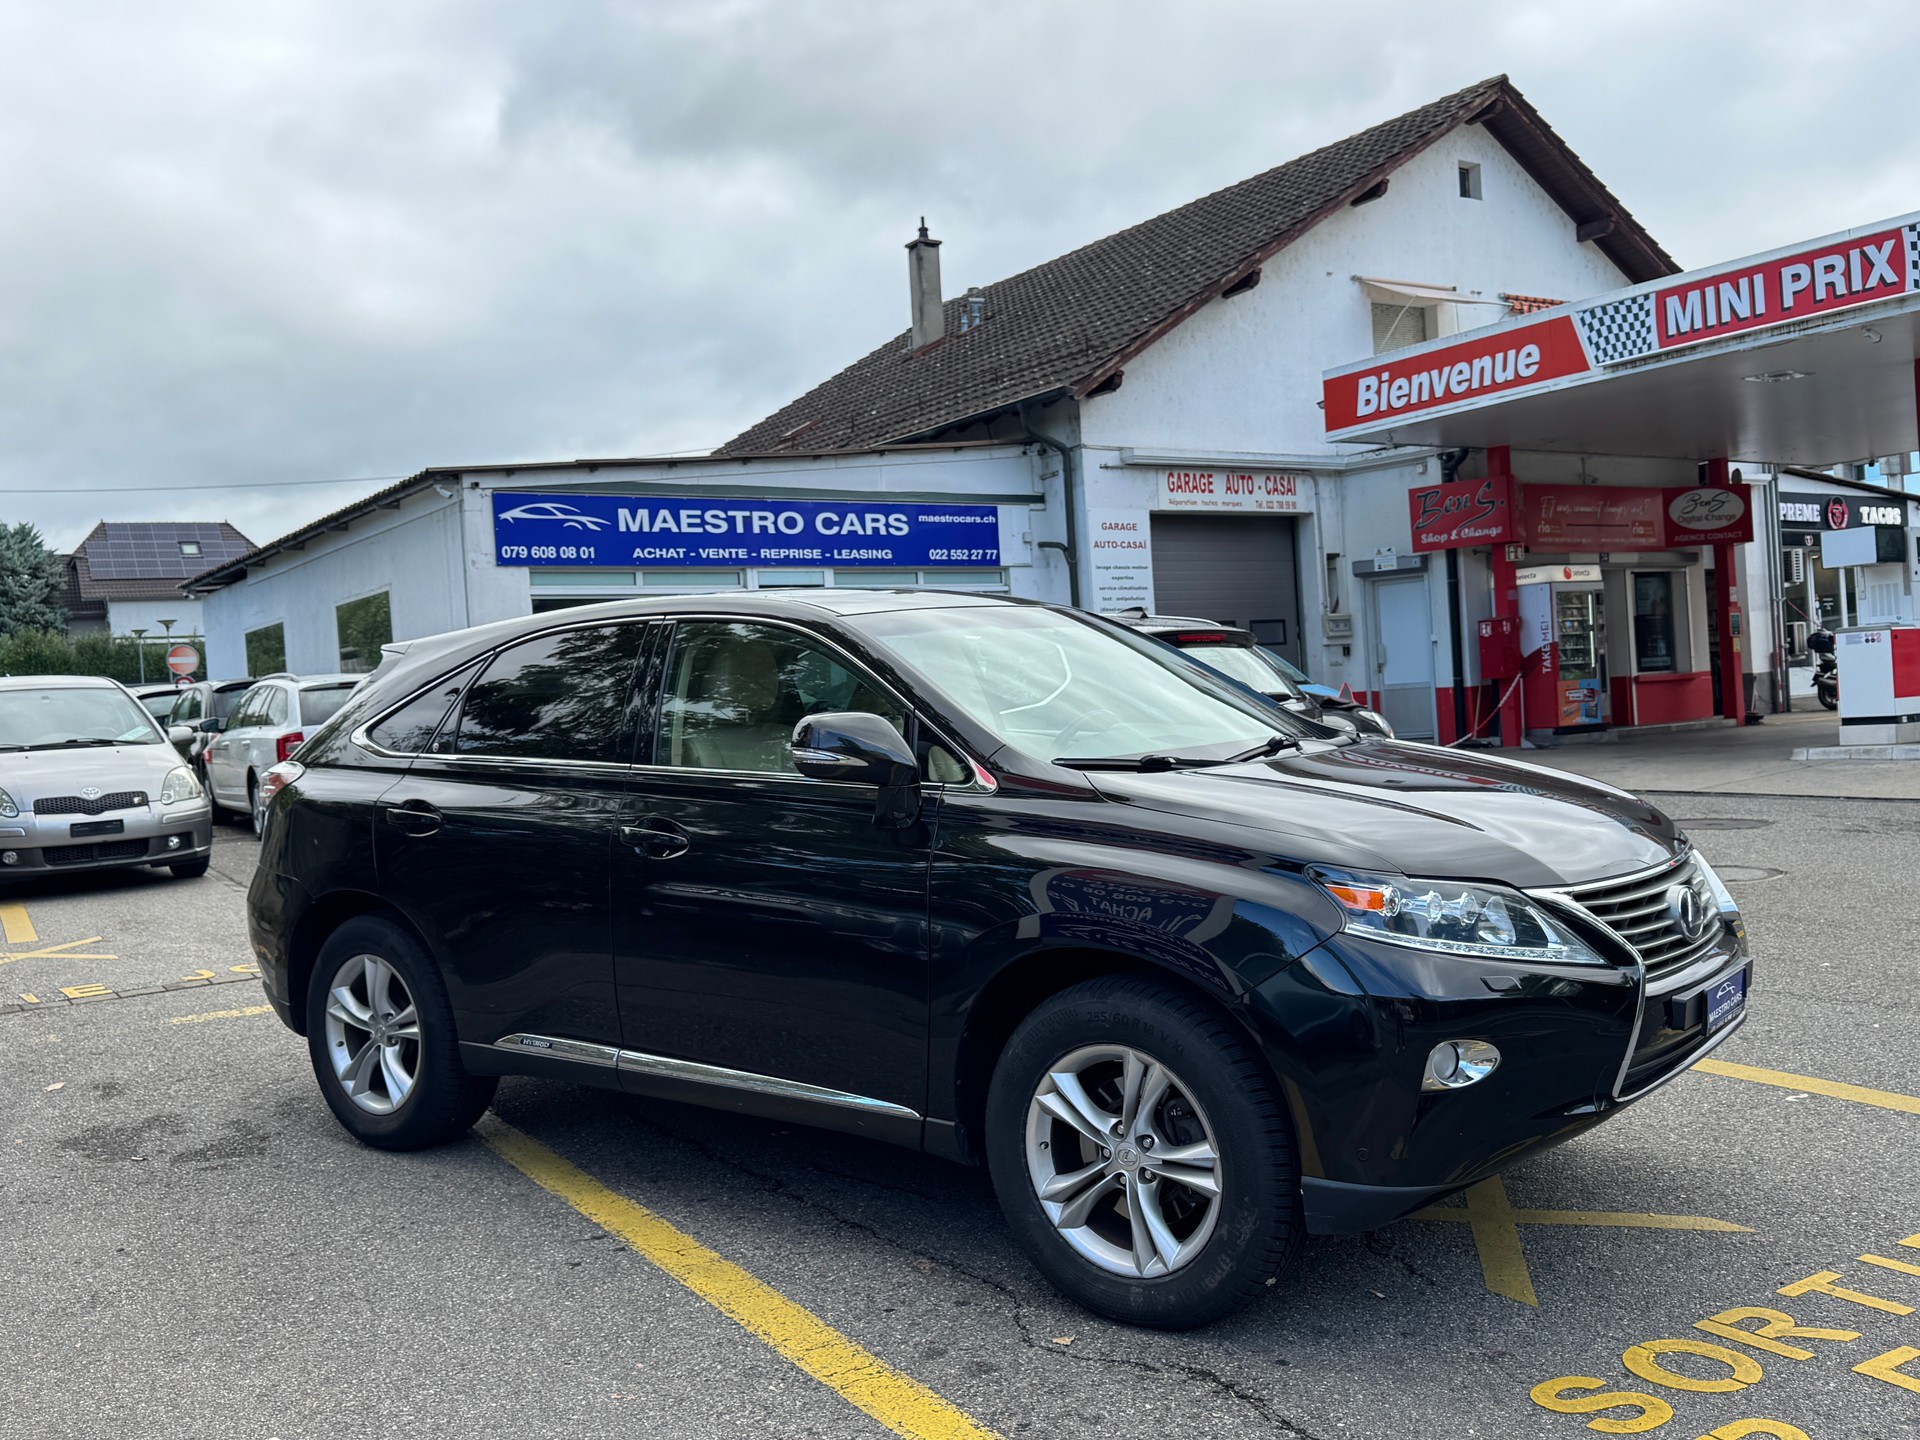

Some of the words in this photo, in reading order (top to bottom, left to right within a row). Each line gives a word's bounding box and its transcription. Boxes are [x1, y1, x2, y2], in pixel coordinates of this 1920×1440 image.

[1664, 272, 1767, 338] MINI
[1780, 238, 1899, 308] PRIX
[1355, 342, 1541, 418] Bienvenue
[1167, 472, 1214, 494] GARAGE
[1225, 474, 1254, 495] AUTO
[1413, 488, 1470, 531] Ben
[1779, 502, 1821, 522] PREME
[1859, 506, 1902, 525] TACOS
[617, 507, 804, 535] MAESTRO
[815, 512, 910, 536] CARS
[918, 515, 996, 524] maestrocars.ch
[1101, 522, 1138, 531] GARAGE
[1420, 533, 1448, 544] Shop
[1450, 529, 1458, 540] &
[1460, 526, 1503, 538] Change
[1674, 532, 1706, 542] AGENCE
[1707, 531, 1743, 540] CONTACT
[501, 545, 528, 559] 079
[531, 546, 557, 559] 608
[559, 547, 577, 559] 08
[579, 547, 596, 559] 01
[632, 547, 687, 559] ACHAT
[699, 548, 749, 559] VENTE
[761, 549, 822, 560] REPRISE
[834, 549, 893, 560] LEASING
[929, 549, 948, 560] 022
[950, 550, 970, 560] 552
[971, 550, 984, 560] 27
[985, 550, 997, 560] 77
[1572, 568, 1590, 576] selecta
[1541, 643, 1552, 674] TAKE
[1709, 1000, 1731, 1024] MAESTRO
[1730, 990, 1743, 1008] CARS
[1087, 1011, 1129, 1025] 255/60
[1132, 1019, 1140, 1030] R
[1143, 1021, 1156, 1035] 18
[522, 1038, 550, 1048] HYBRID
